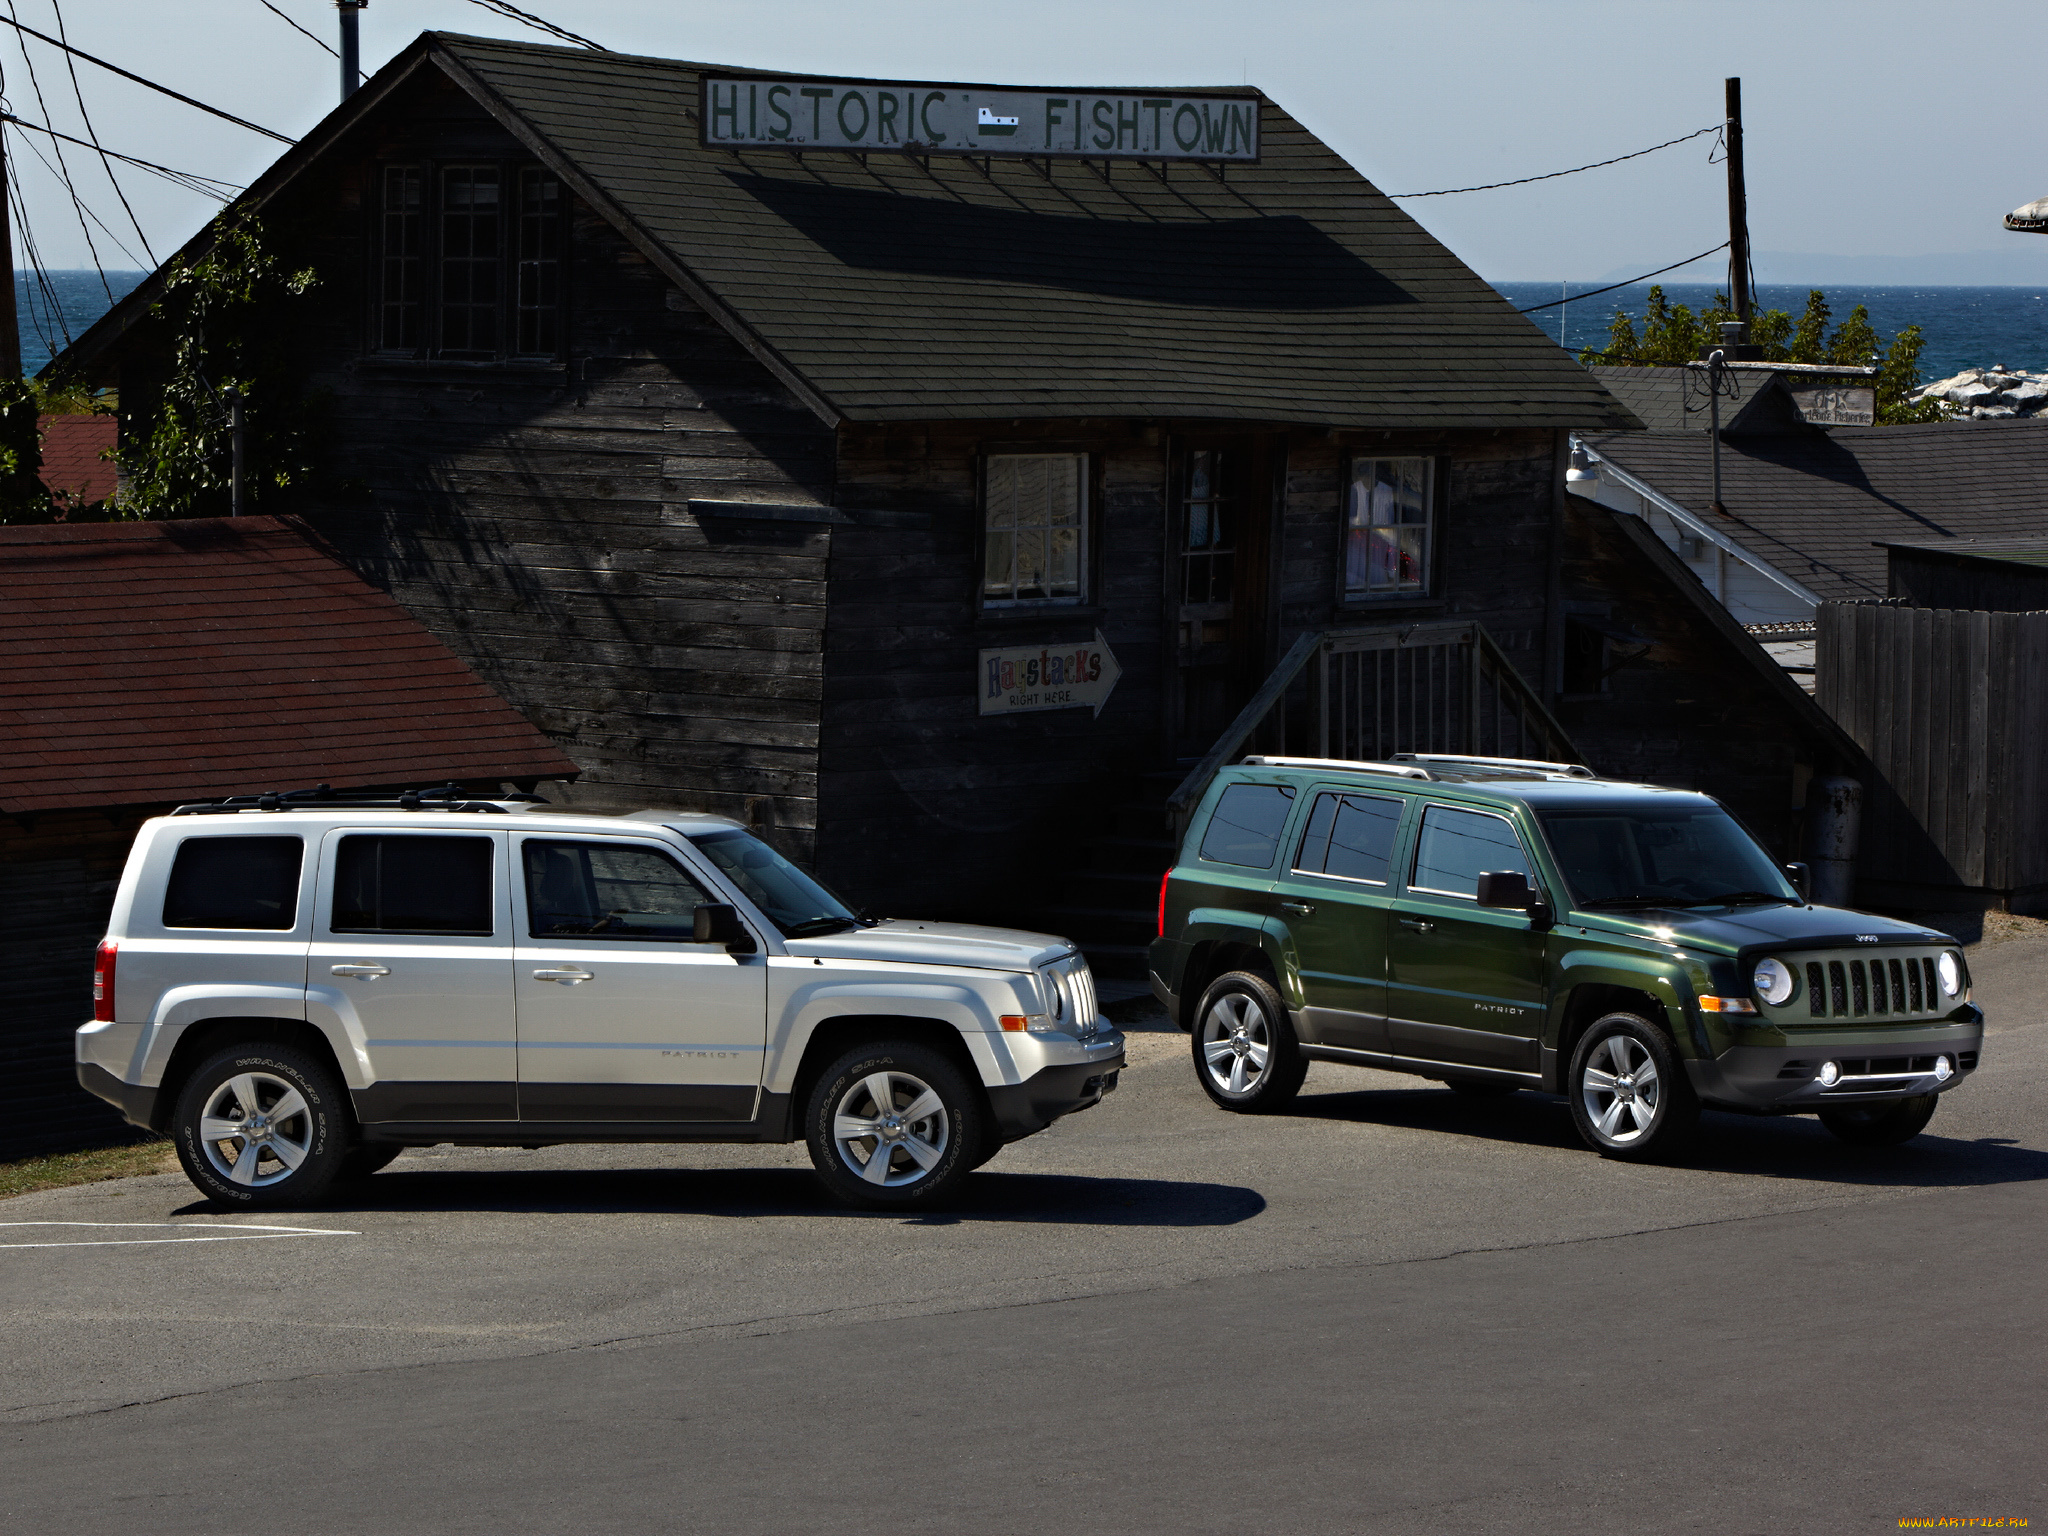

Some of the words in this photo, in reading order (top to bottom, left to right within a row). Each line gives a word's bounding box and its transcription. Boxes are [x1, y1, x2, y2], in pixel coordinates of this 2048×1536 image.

[712, 84, 947, 143] HISTORIC
[1045, 98, 1252, 154] FISHTOWN
[987, 650, 1101, 699] Haystacks
[1010, 694, 1039, 706] RIGHT
[1475, 1004, 1524, 1015] PATRIOT
[236, 1057, 320, 1104] WRANGLER
[820, 1077, 845, 1172] WRANGLER
[913, 1109, 962, 1196] GOODYEAR
[185, 1126, 251, 1200] GOODYEAR
